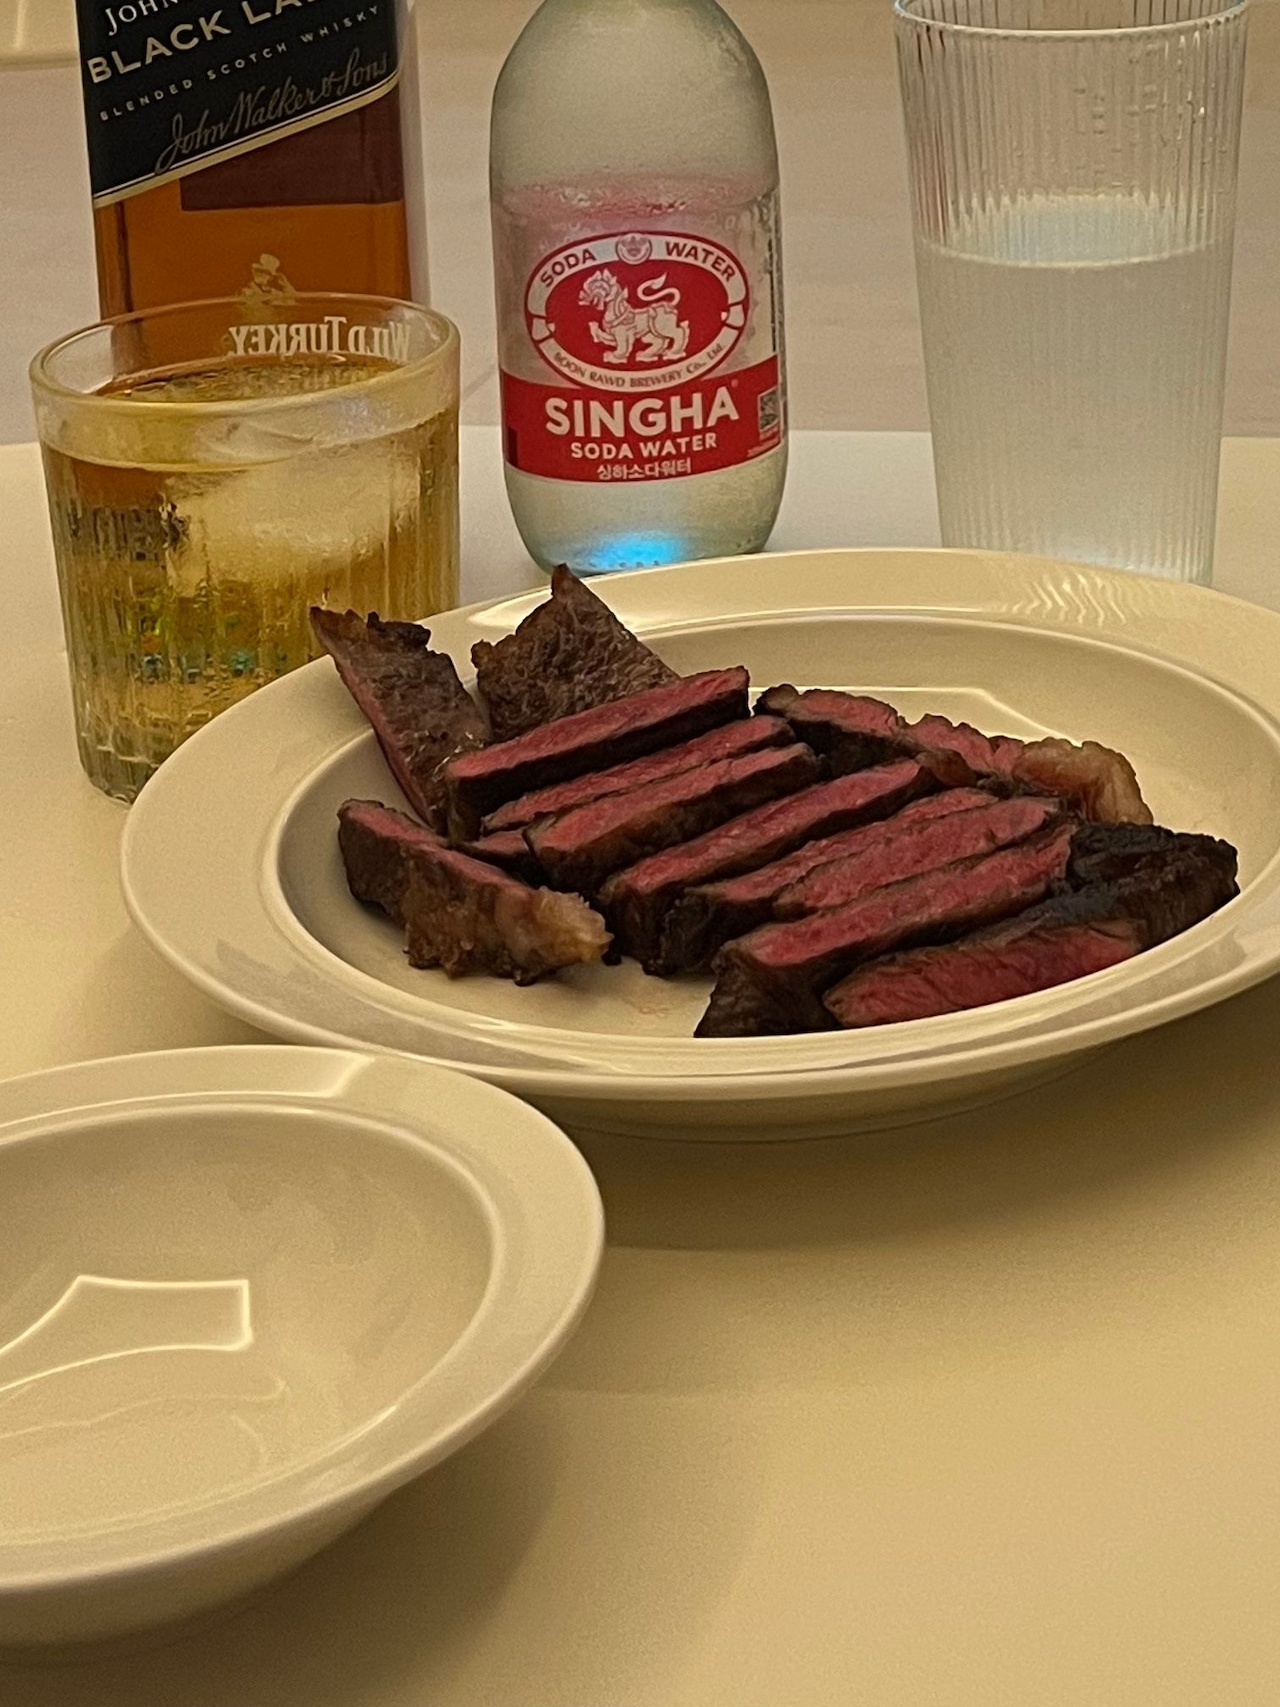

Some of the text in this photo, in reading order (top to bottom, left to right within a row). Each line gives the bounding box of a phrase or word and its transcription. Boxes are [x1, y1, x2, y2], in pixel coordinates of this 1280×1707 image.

[88, 10, 231, 83] BLACK
[100, 5, 379, 121] BLENDED SCOTCH WHISKY
[540, 241, 736, 288] SODA WATER
[554, 351, 586, 378] BOON
[630, 368, 683, 388] BREWERY
[544, 386, 739, 438] SINGHA
[570, 432, 717, 460] SODA WATER
[596, 457, 691, 481] 싱하소다워터
